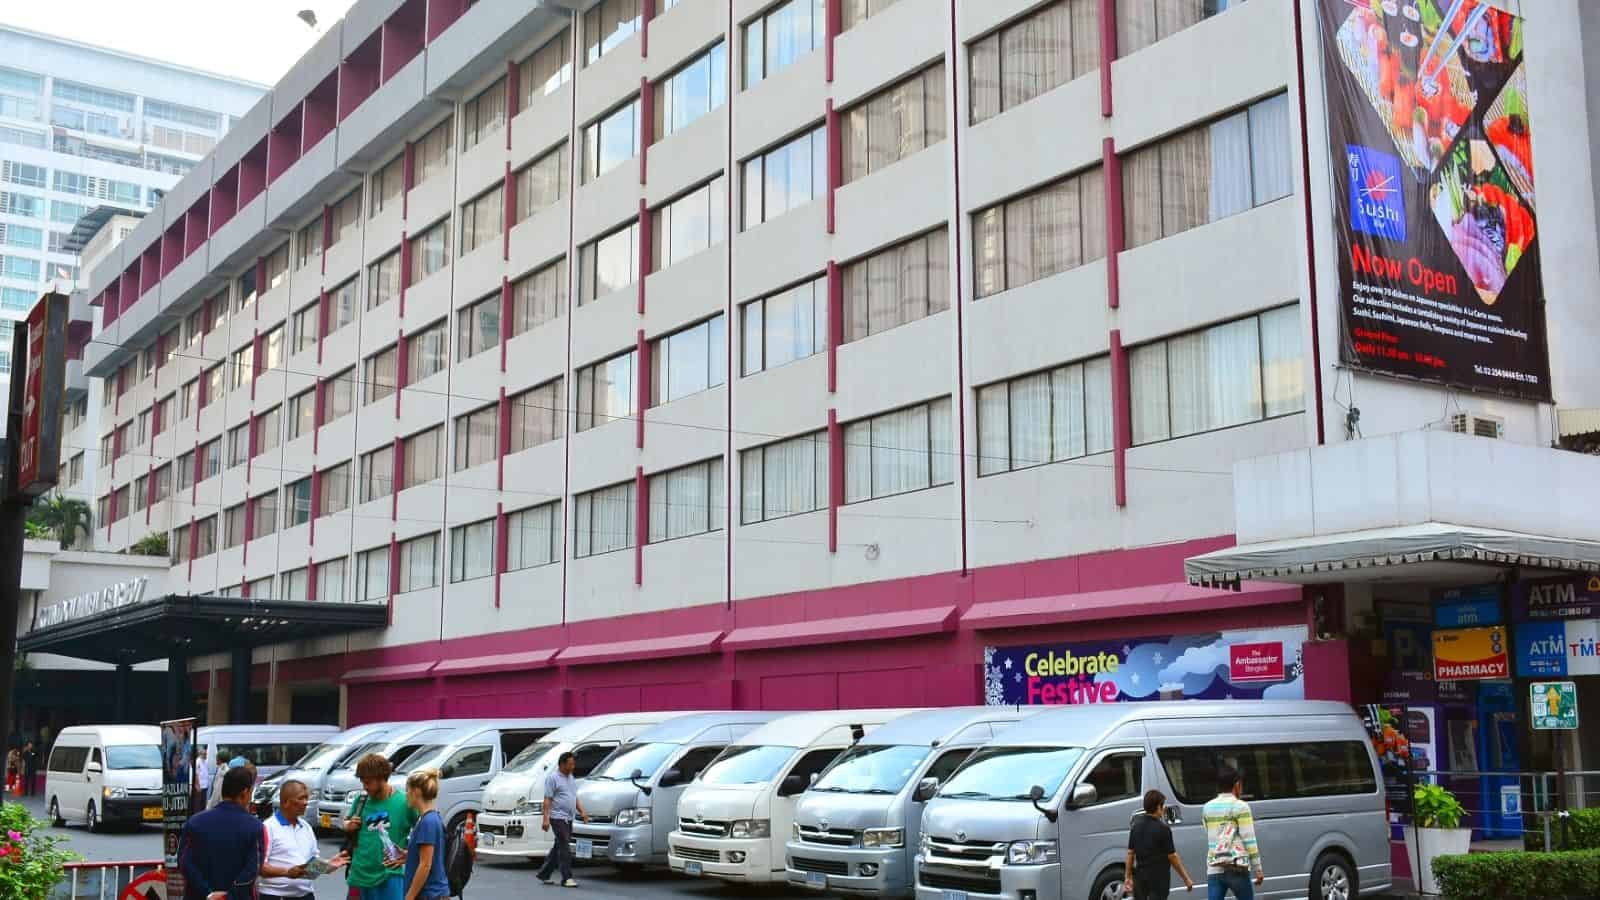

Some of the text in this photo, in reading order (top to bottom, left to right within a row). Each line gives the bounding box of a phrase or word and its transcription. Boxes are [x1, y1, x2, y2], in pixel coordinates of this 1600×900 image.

[1351, 243, 1457, 296] Now Open
[1352, 294, 1365, 304] Our
[1529, 583, 1577, 605] ATM
[1529, 635, 1565, 656] ATM
[1024, 650, 1119, 678] Celebrate
[1235, 655, 1279, 665] Ambassador
[1438, 663, 1505, 678] PHARMACY
[1026, 675, 1119, 704] Festive
